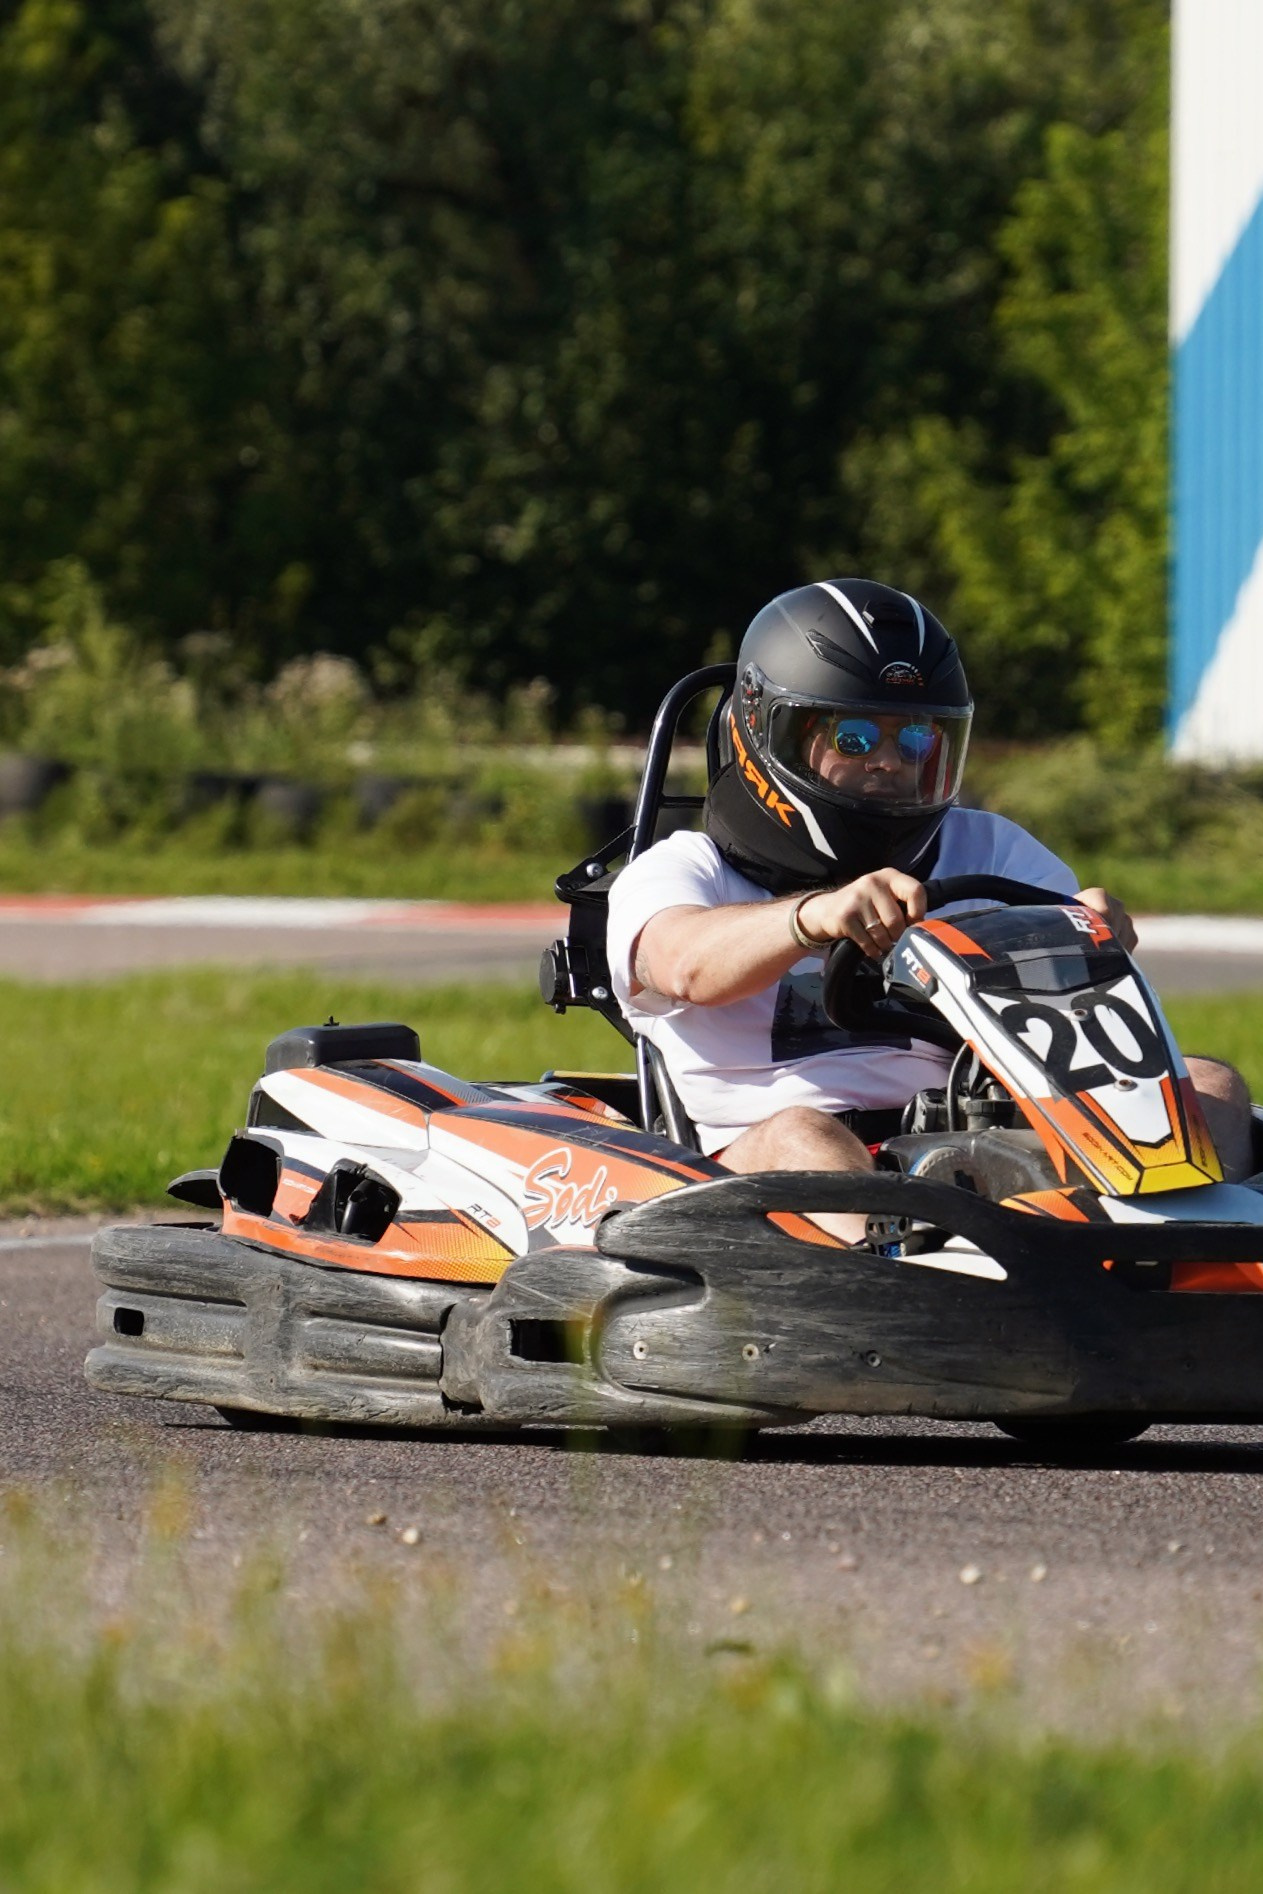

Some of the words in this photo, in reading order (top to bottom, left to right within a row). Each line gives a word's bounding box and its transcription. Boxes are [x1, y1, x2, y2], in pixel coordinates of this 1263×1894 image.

[730, 712, 796, 828] ARK
[901, 946, 931, 986] RT8
[1000, 991, 1169, 1093] 20
[466, 1203, 503, 1229] RT8
[522, 1146, 618, 1232] Sodi
